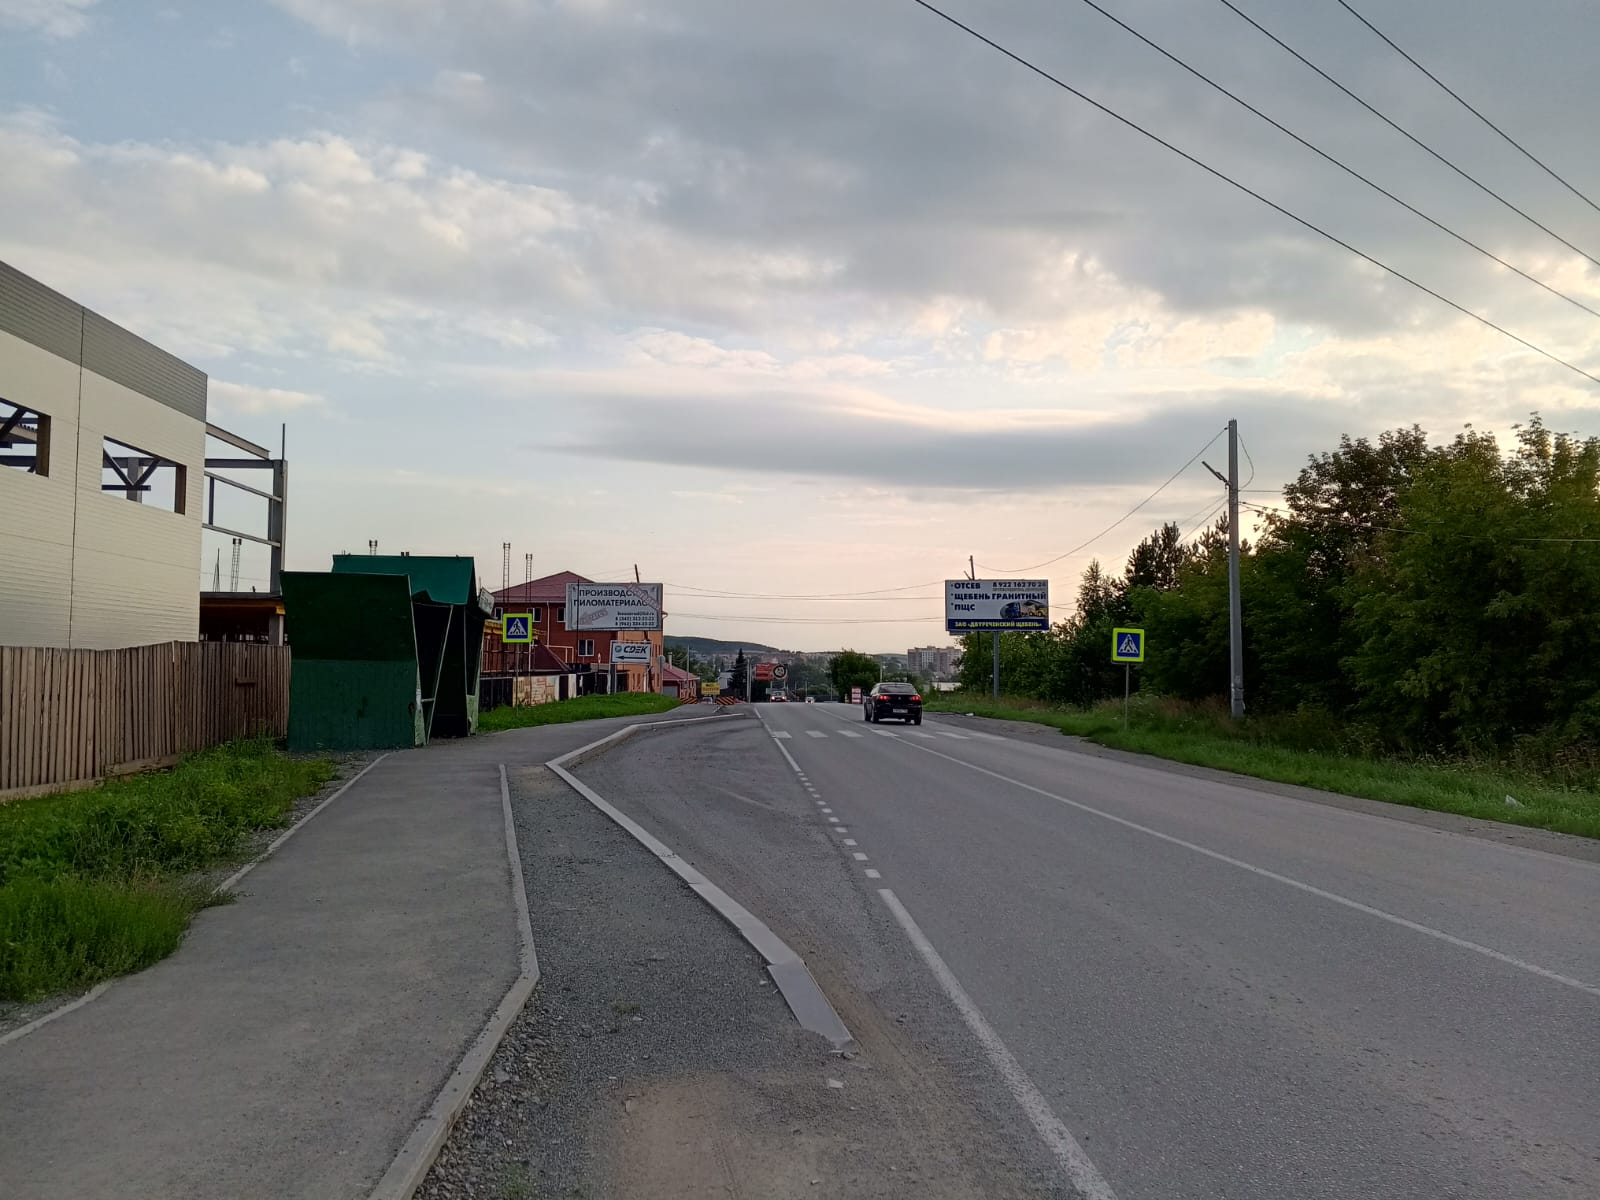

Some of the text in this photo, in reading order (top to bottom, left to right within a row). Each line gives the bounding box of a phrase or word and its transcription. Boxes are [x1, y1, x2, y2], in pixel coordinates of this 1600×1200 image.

[954, 592, 1046, 601] ЩЕБЕНЬ ГРАНИТНЫЙ
[954, 603, 976, 611] ПЩС
